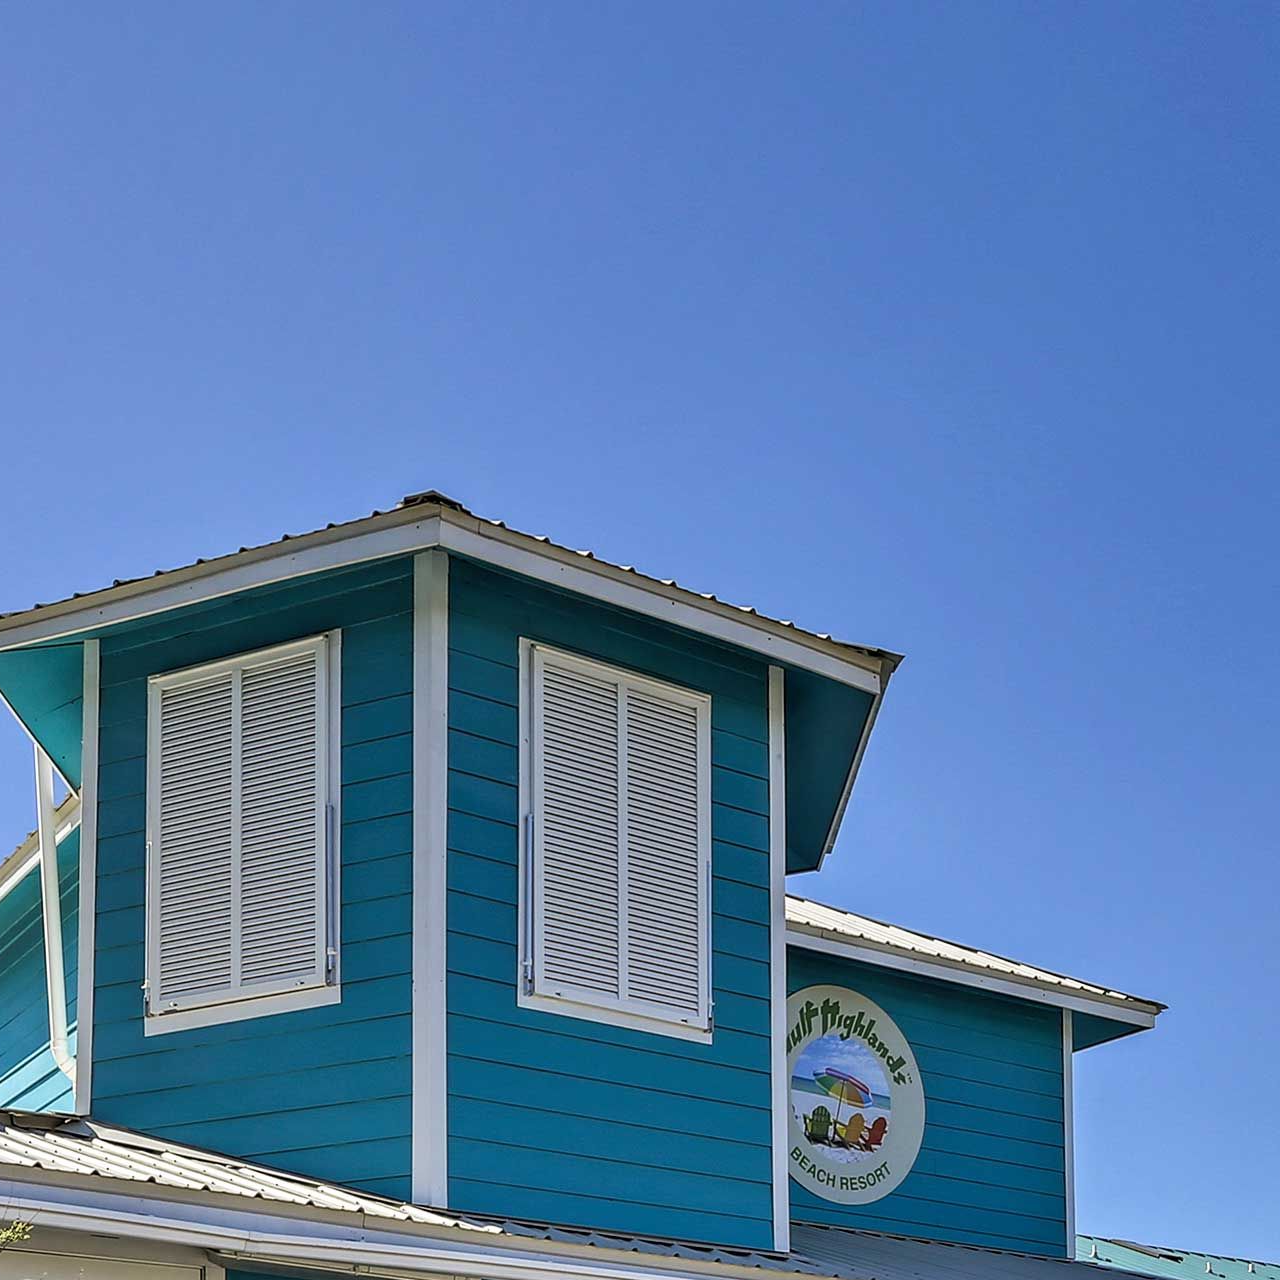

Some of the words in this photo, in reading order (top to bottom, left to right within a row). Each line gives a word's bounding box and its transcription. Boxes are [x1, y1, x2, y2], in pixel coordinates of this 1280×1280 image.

[786, 1000, 819, 1054] ulf
[790, 1146, 836, 1188] BEACH
[840, 1161, 891, 1190] RESORT
